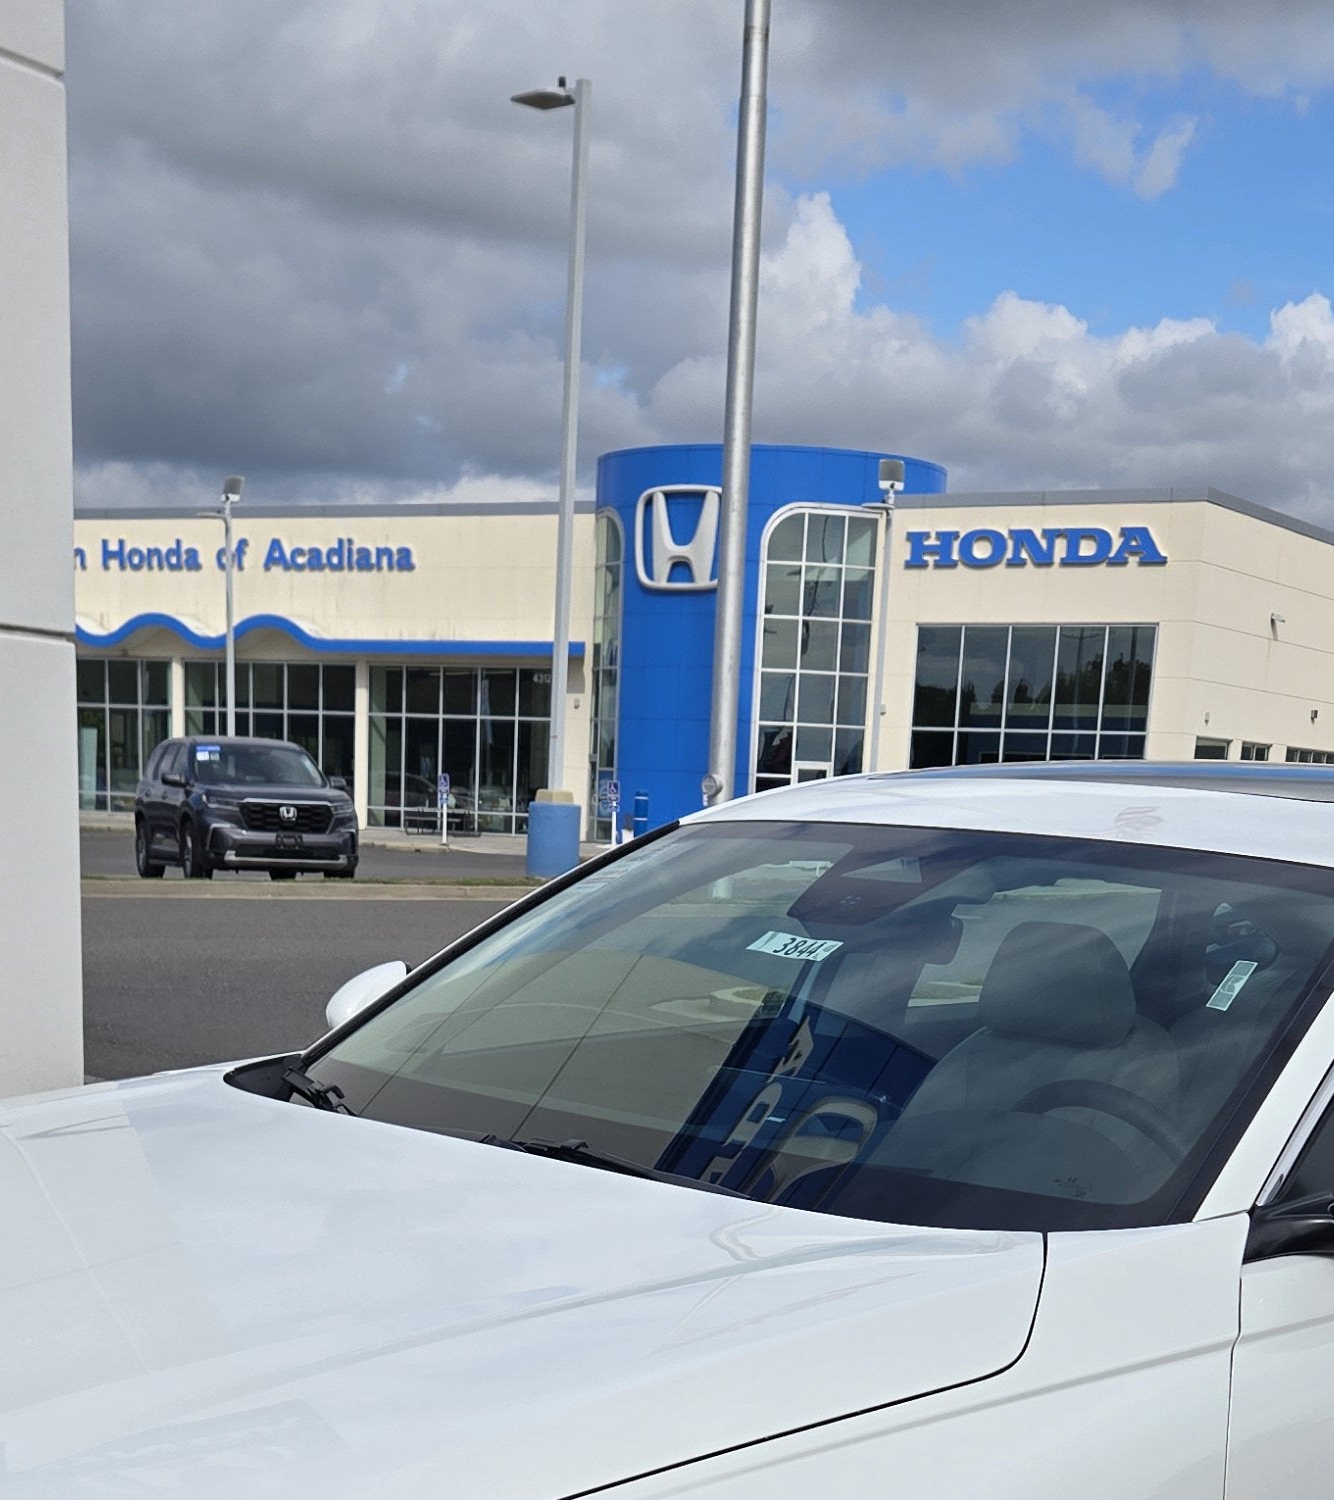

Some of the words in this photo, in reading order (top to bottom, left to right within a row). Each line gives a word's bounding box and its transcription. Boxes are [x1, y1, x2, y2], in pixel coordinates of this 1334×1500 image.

[100, 537, 203, 572] Honda
[215, 537, 249, 572] of
[262, 537, 416, 572] Acadiana
[904, 526, 1168, 569] HONDA
[772, 937, 828, 958] 3844
